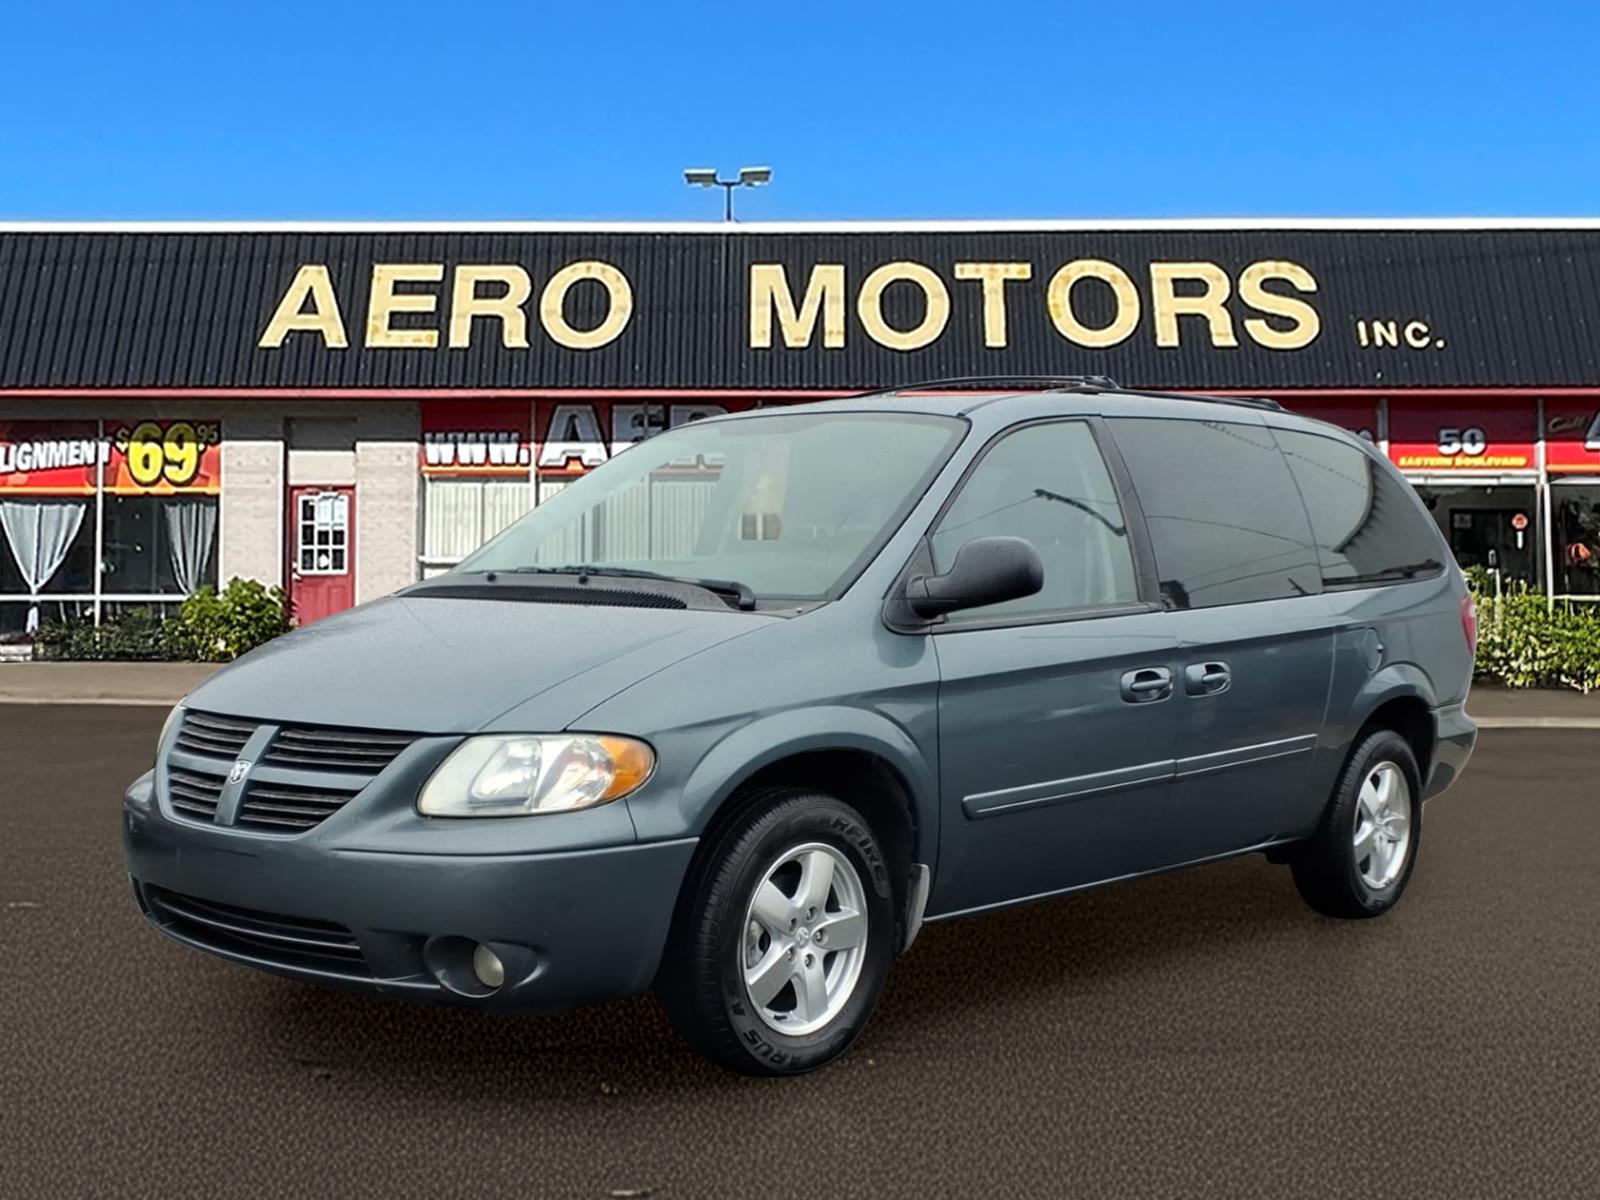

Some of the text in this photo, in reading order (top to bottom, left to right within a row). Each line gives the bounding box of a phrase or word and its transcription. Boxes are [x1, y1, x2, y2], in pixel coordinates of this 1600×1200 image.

[258, 260, 1446, 350] AERO MOTORS INC.
[1437, 428, 1486, 455] 50
[1399, 455, 1527, 467] EASTERN BOULEVARD
